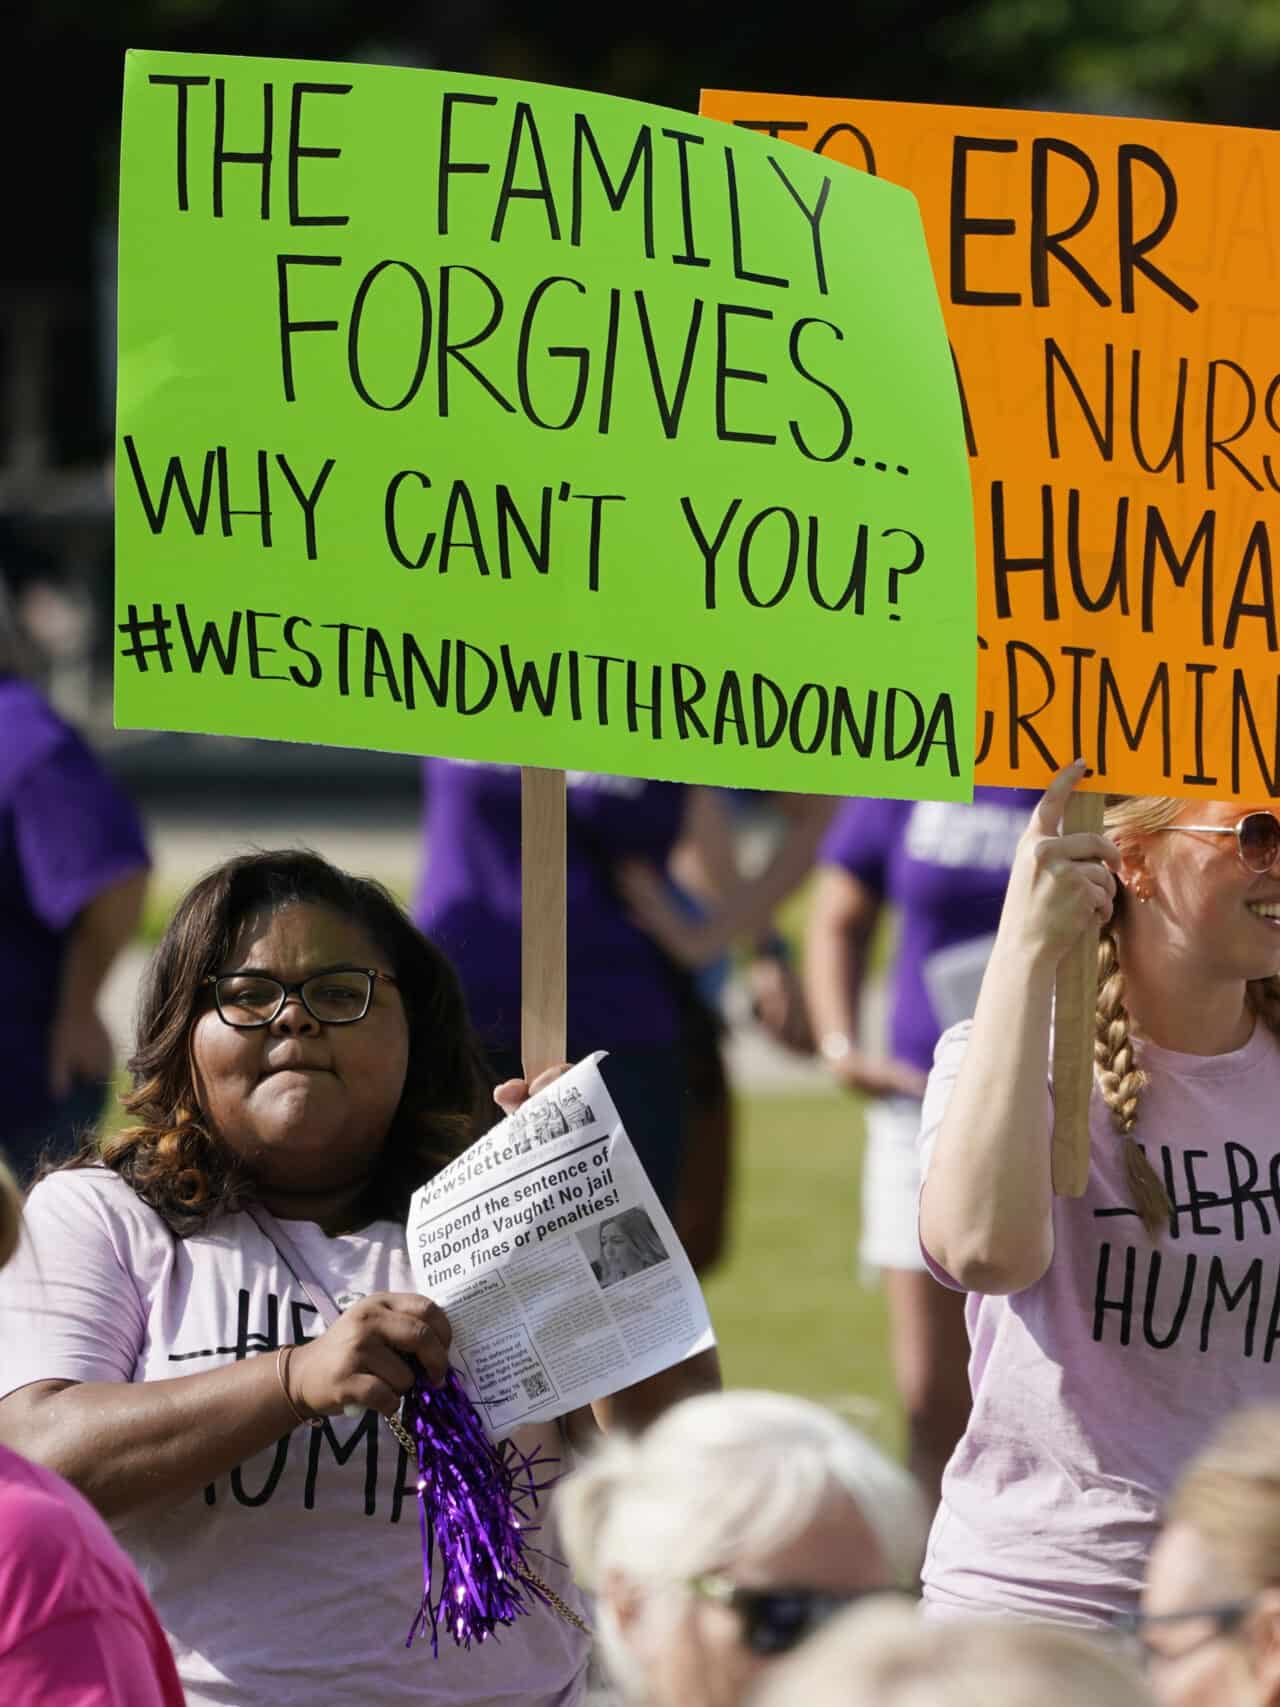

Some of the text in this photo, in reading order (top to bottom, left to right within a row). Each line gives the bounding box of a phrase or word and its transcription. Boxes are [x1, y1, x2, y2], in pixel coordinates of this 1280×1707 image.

[149, 75, 831, 295] THE FAMILY
[951, 136, 1198, 313] ERR
[277, 254, 909, 476] FORGIVES...
[124, 435, 925, 622] WHY CAN'T YOU?
[118, 604, 961, 777] #WESTANDWITHRADONDA
[418, 1205, 481, 1248] Suspend
[485, 1194, 511, 1216] the
[514, 1161, 588, 1201] sentence
[592, 1146, 609, 1167] of
[420, 1141, 521, 1208] Newsletter
[423, 1167, 614, 1269] RaDonda Vaught! No jail
[427, 1189, 620, 1288] time, fines or penalties!
[235, 1288, 319, 1360] HE
